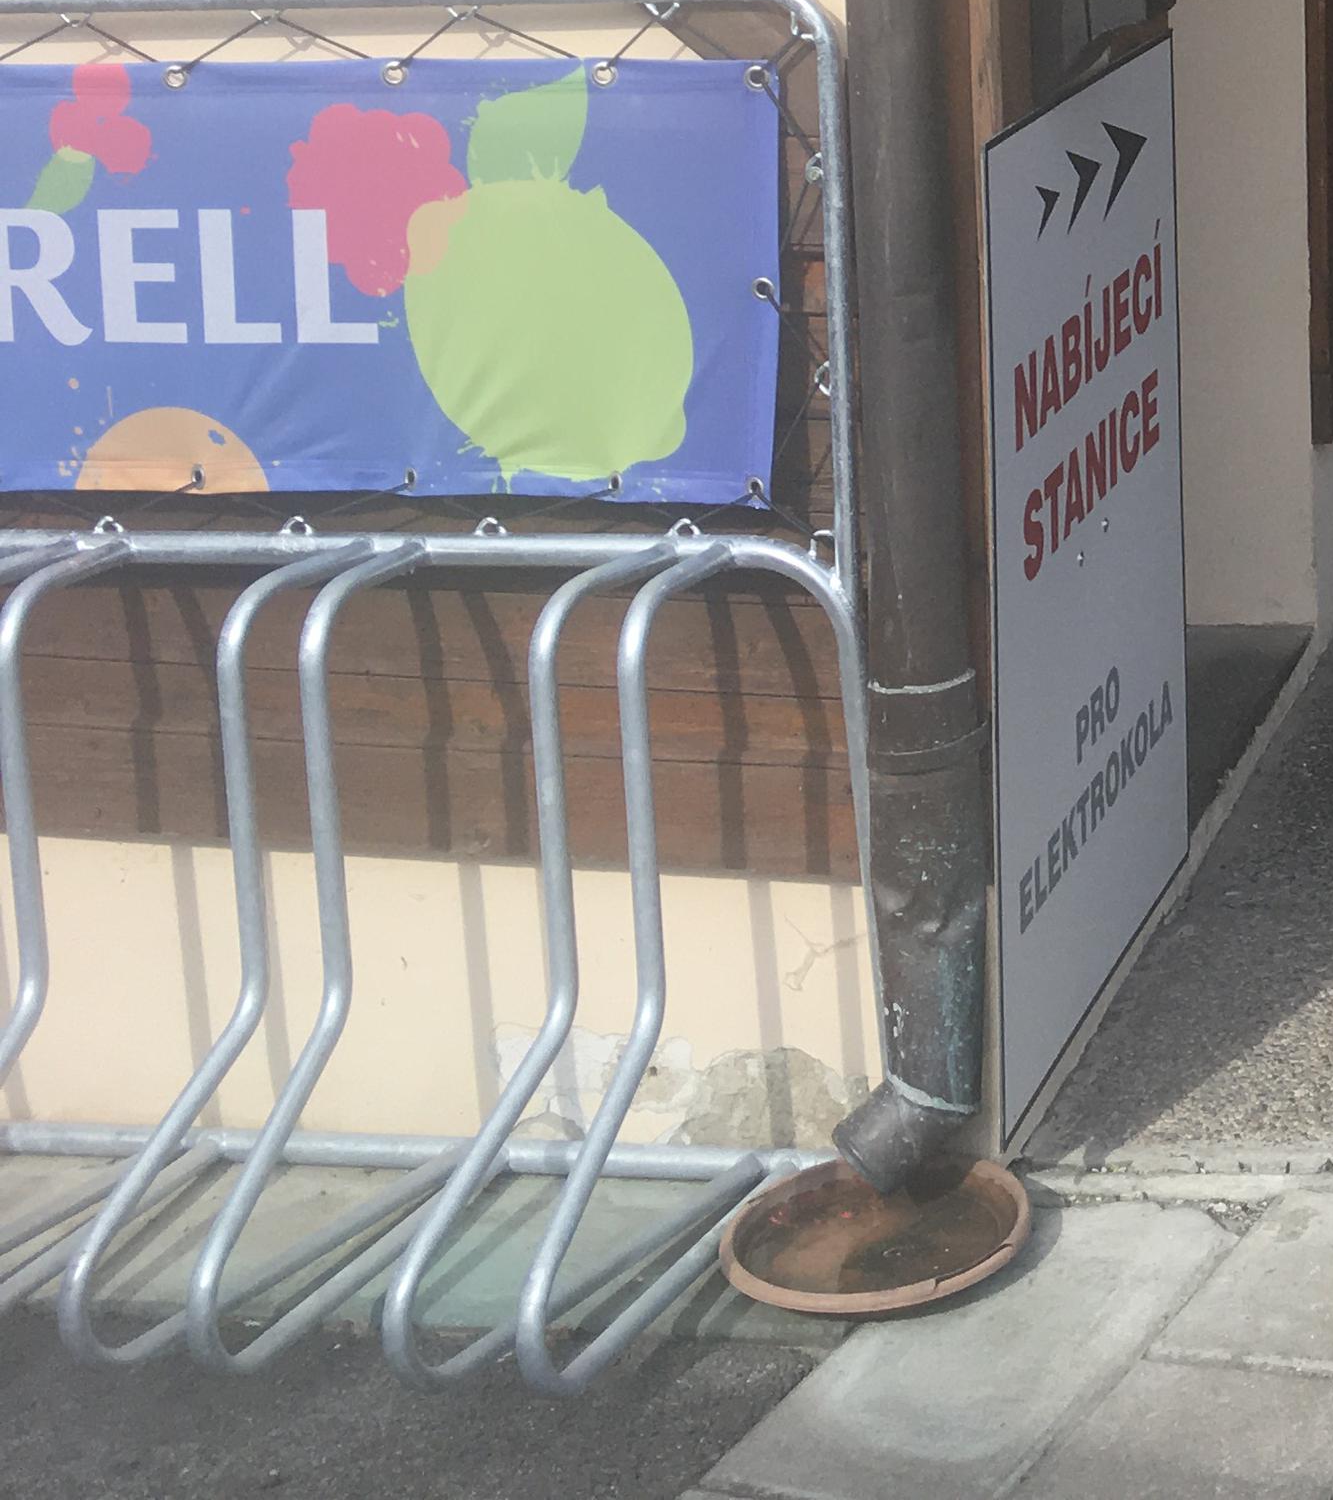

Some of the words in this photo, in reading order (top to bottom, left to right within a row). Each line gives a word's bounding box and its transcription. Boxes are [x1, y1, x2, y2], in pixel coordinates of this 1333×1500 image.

[1013, 218, 1162, 453] NABÍJECÍ
[1023, 368, 1160, 581] STANICE
[1019, 680, 1173, 935] ELEKTROKOLA
[1075, 665, 1120, 766] PRO
